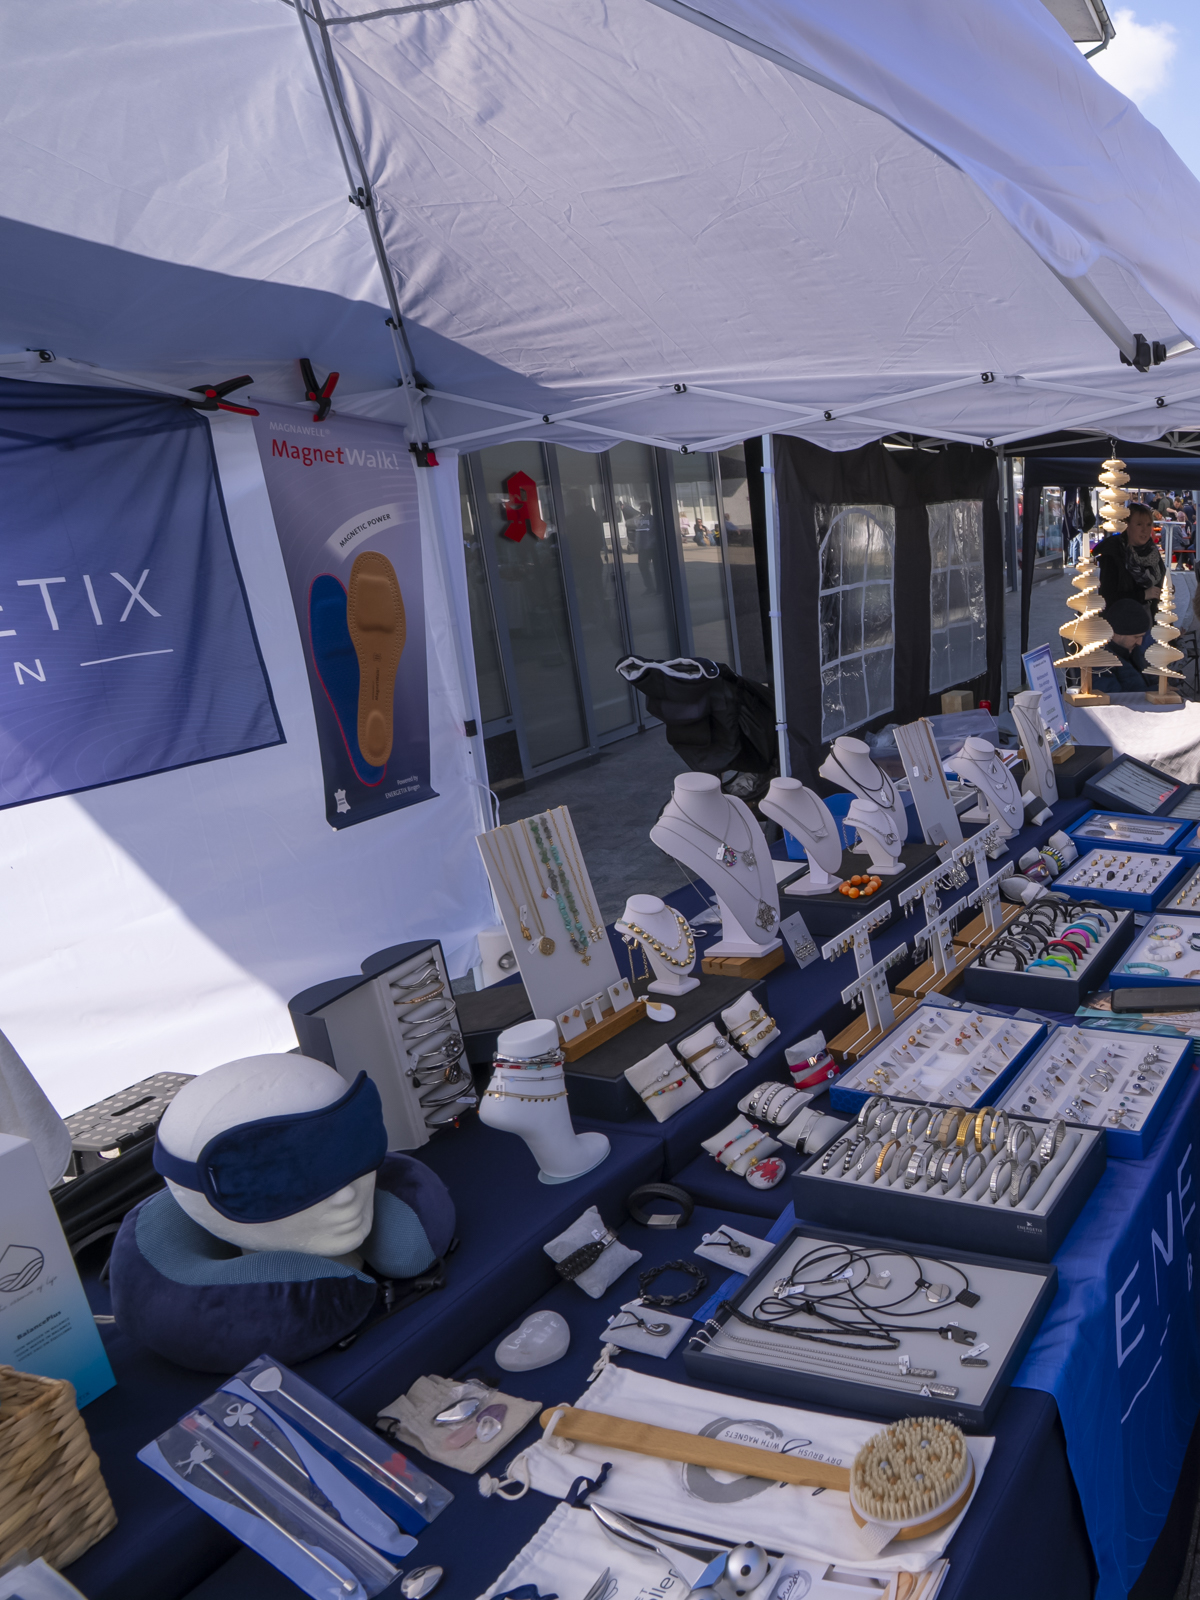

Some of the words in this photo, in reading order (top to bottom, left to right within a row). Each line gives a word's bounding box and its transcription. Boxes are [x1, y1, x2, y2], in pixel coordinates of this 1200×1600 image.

[339, 523, 368, 548] MAGNETIC
[367, 513, 391, 527] POWER
[16, 1311, 62, 1340] BalancePlus
[724, 1430, 759, 1445] MAGNETS
[760, 1440, 780, 1450] WITH
[797, 1448, 825, 1460] BRUSH
[825, 1456, 843, 1466] DRY
